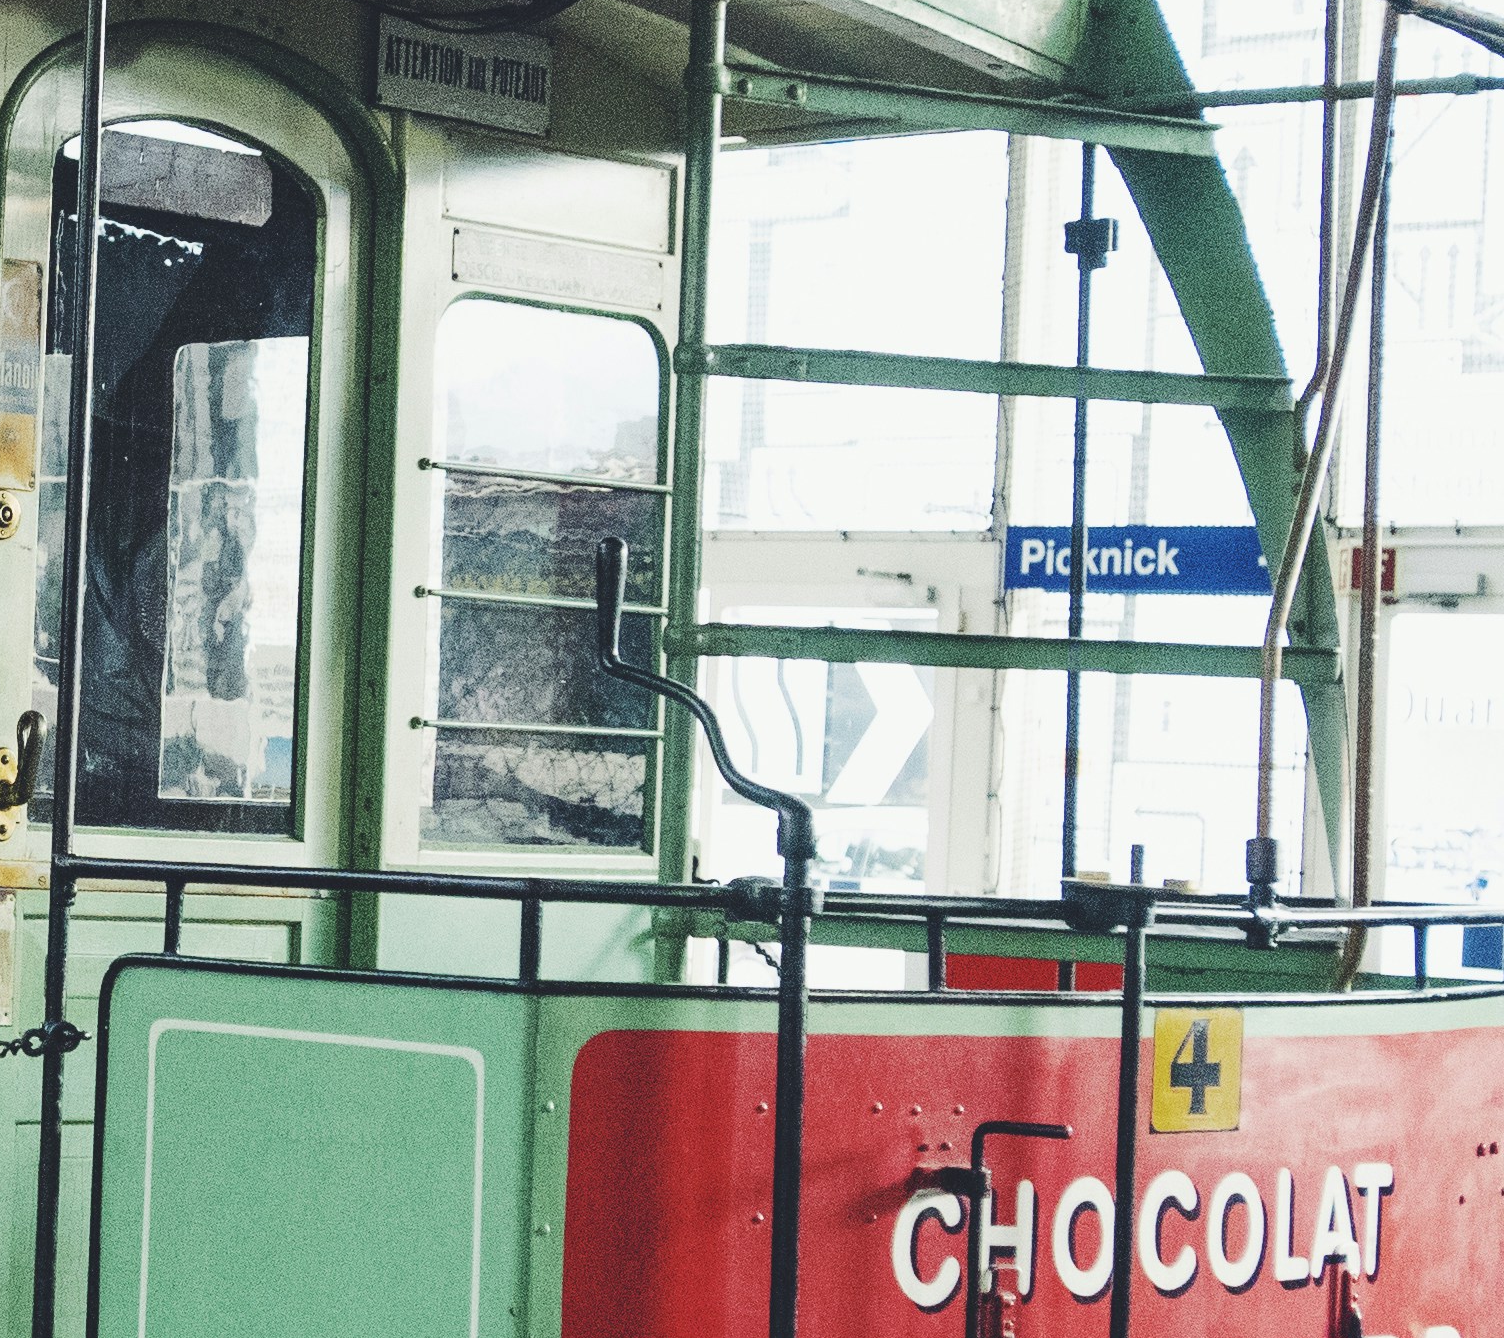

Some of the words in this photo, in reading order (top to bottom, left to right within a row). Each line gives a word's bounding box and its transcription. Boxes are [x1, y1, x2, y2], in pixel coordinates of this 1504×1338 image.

[383, 35, 464, 88] ATTENTION
[1020, 538, 1180, 576] Picknick
[1170, 1018, 1222, 1115] 4
[892, 1162, 1393, 1308] CHOCOLAT
